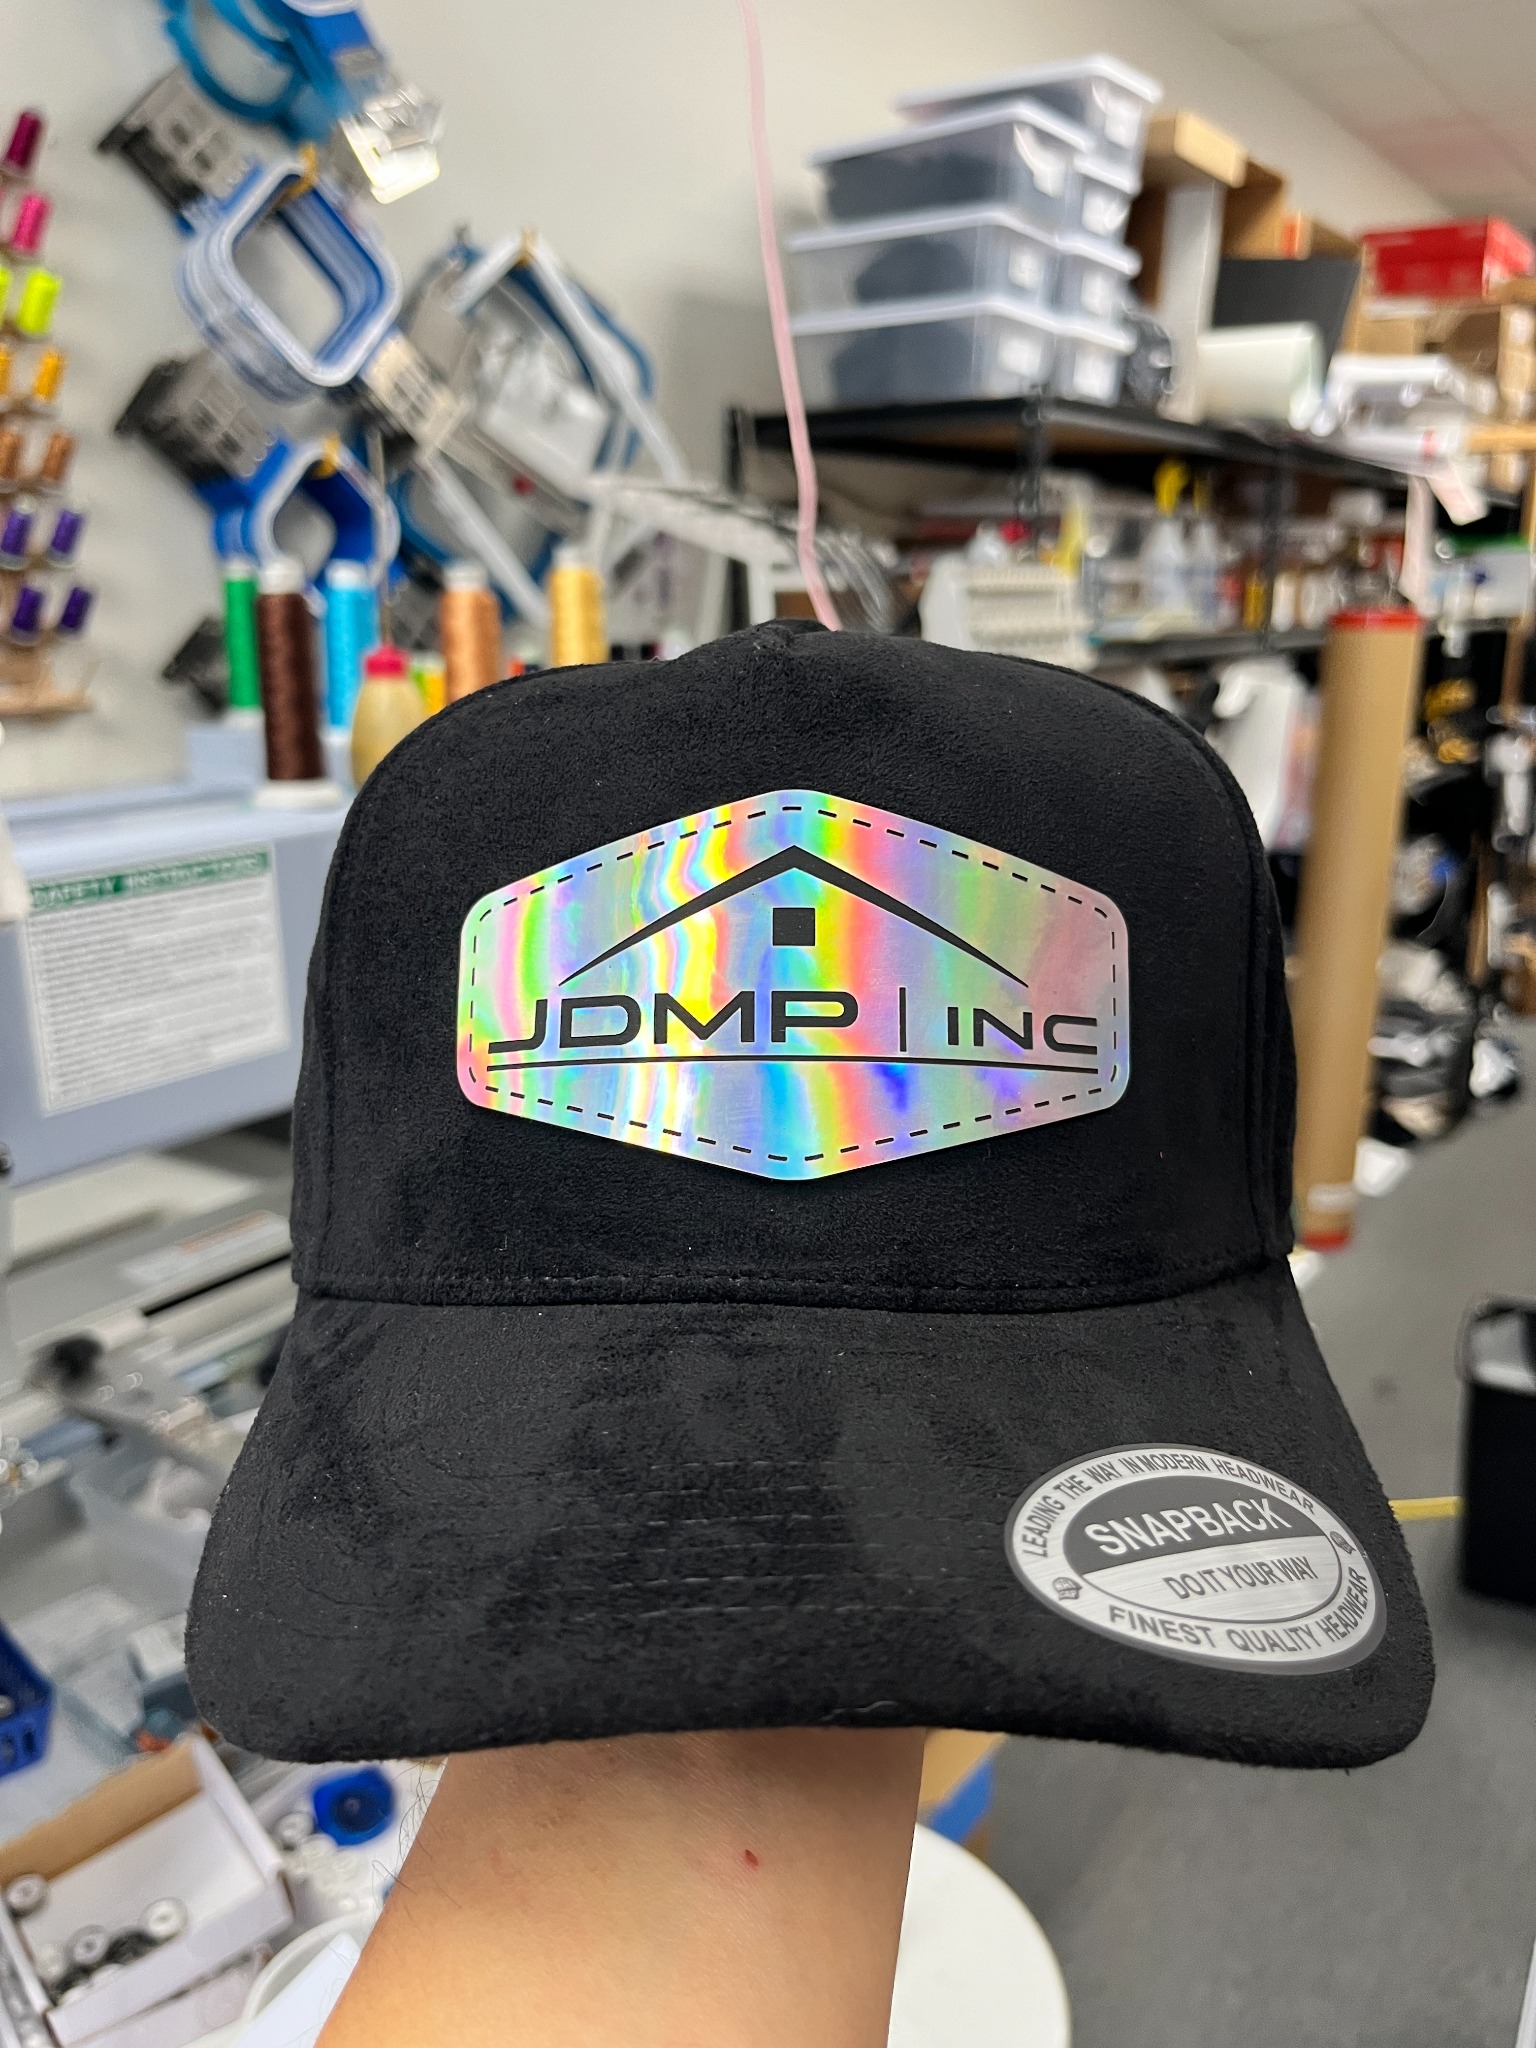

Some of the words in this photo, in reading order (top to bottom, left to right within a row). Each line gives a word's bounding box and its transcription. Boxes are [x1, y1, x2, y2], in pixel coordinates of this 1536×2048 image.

[488, 991, 859, 1054] JDMP
[947, 1006, 1098, 1055] INC
[1022, 1495, 1066, 1557] LEADING
[1052, 1475, 1093, 1500] THE
[1082, 1461, 1123, 1484] WAY
[1118, 1456, 1146, 1474] IN
[1137, 1453, 1212, 1472] MODERN
[1210, 1457, 1315, 1516] HEADWEAR
[1084, 1497, 1293, 1556] SNAPBACK
[1109, 1604, 1217, 1648] FINEST
[1226, 1623, 1322, 1654] QUALITY
[1315, 1566, 1369, 1643] HEADWEAR
[1162, 1573, 1202, 1600] DO
[1197, 1568, 1227, 1593] IT
[1217, 1561, 1284, 1589] YOUR
[1271, 1556, 1319, 1584] WAY
